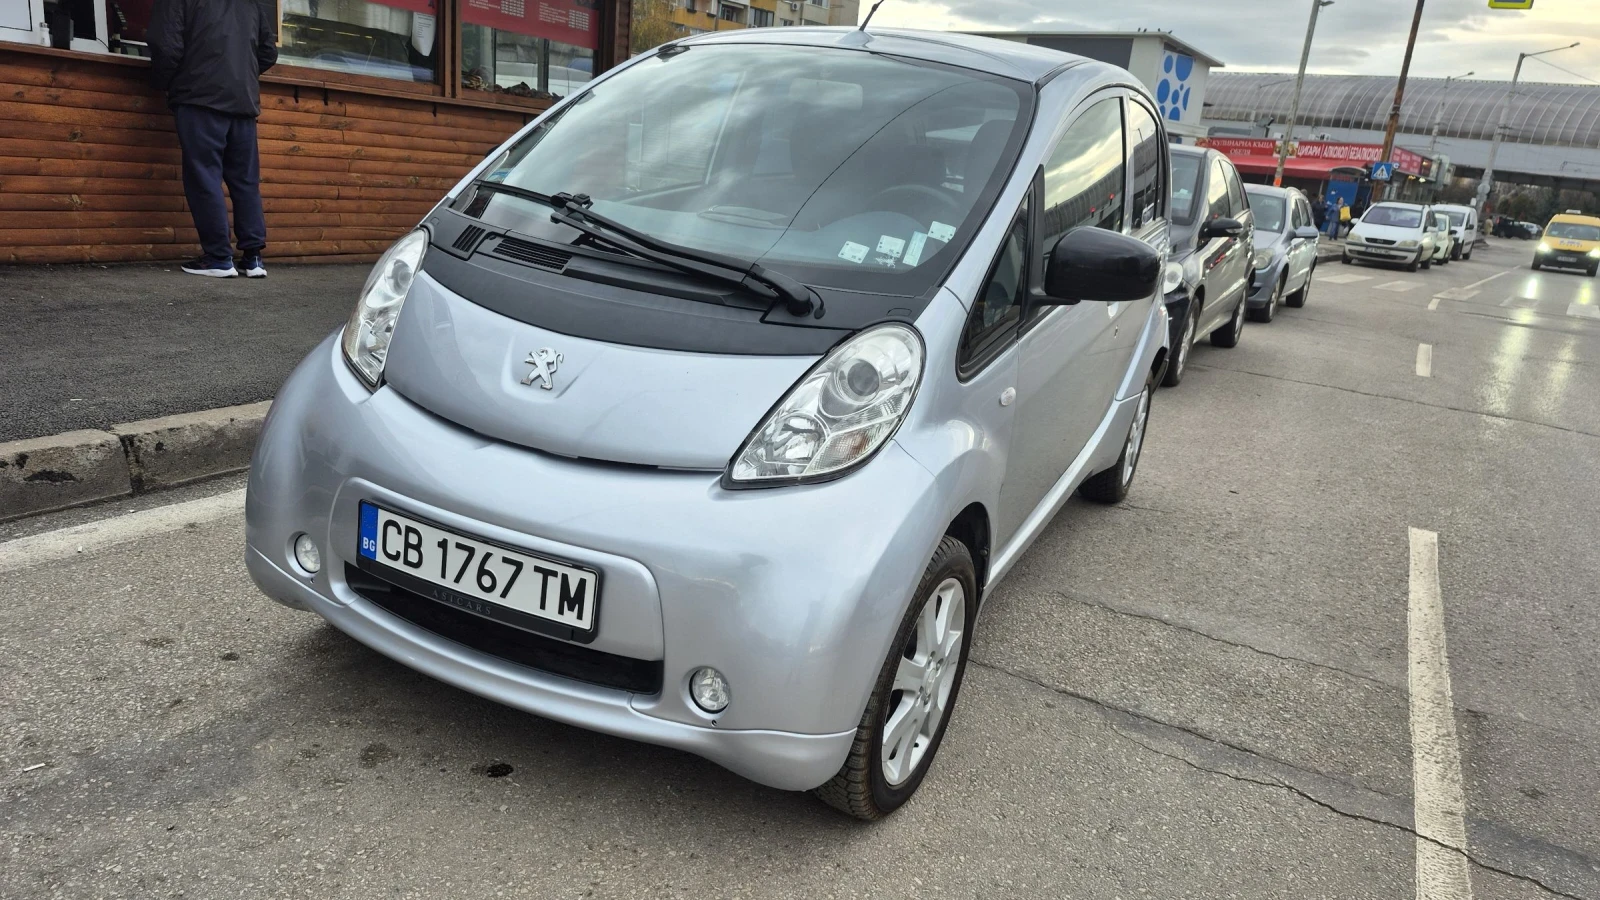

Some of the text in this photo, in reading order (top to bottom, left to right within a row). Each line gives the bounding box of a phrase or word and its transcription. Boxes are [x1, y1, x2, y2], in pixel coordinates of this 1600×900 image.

[1212, 140, 1274, 149] КУЛИНАРНА КЪЩА
[1297, 144, 1321, 157] ЦИГАРИ
[1322, 145, 1350, 159] АЛКОХОЛ
[362, 536, 376, 552] BG
[382, 519, 587, 621] CB 1767 TM
[432, 589, 492, 616] ASICARS
